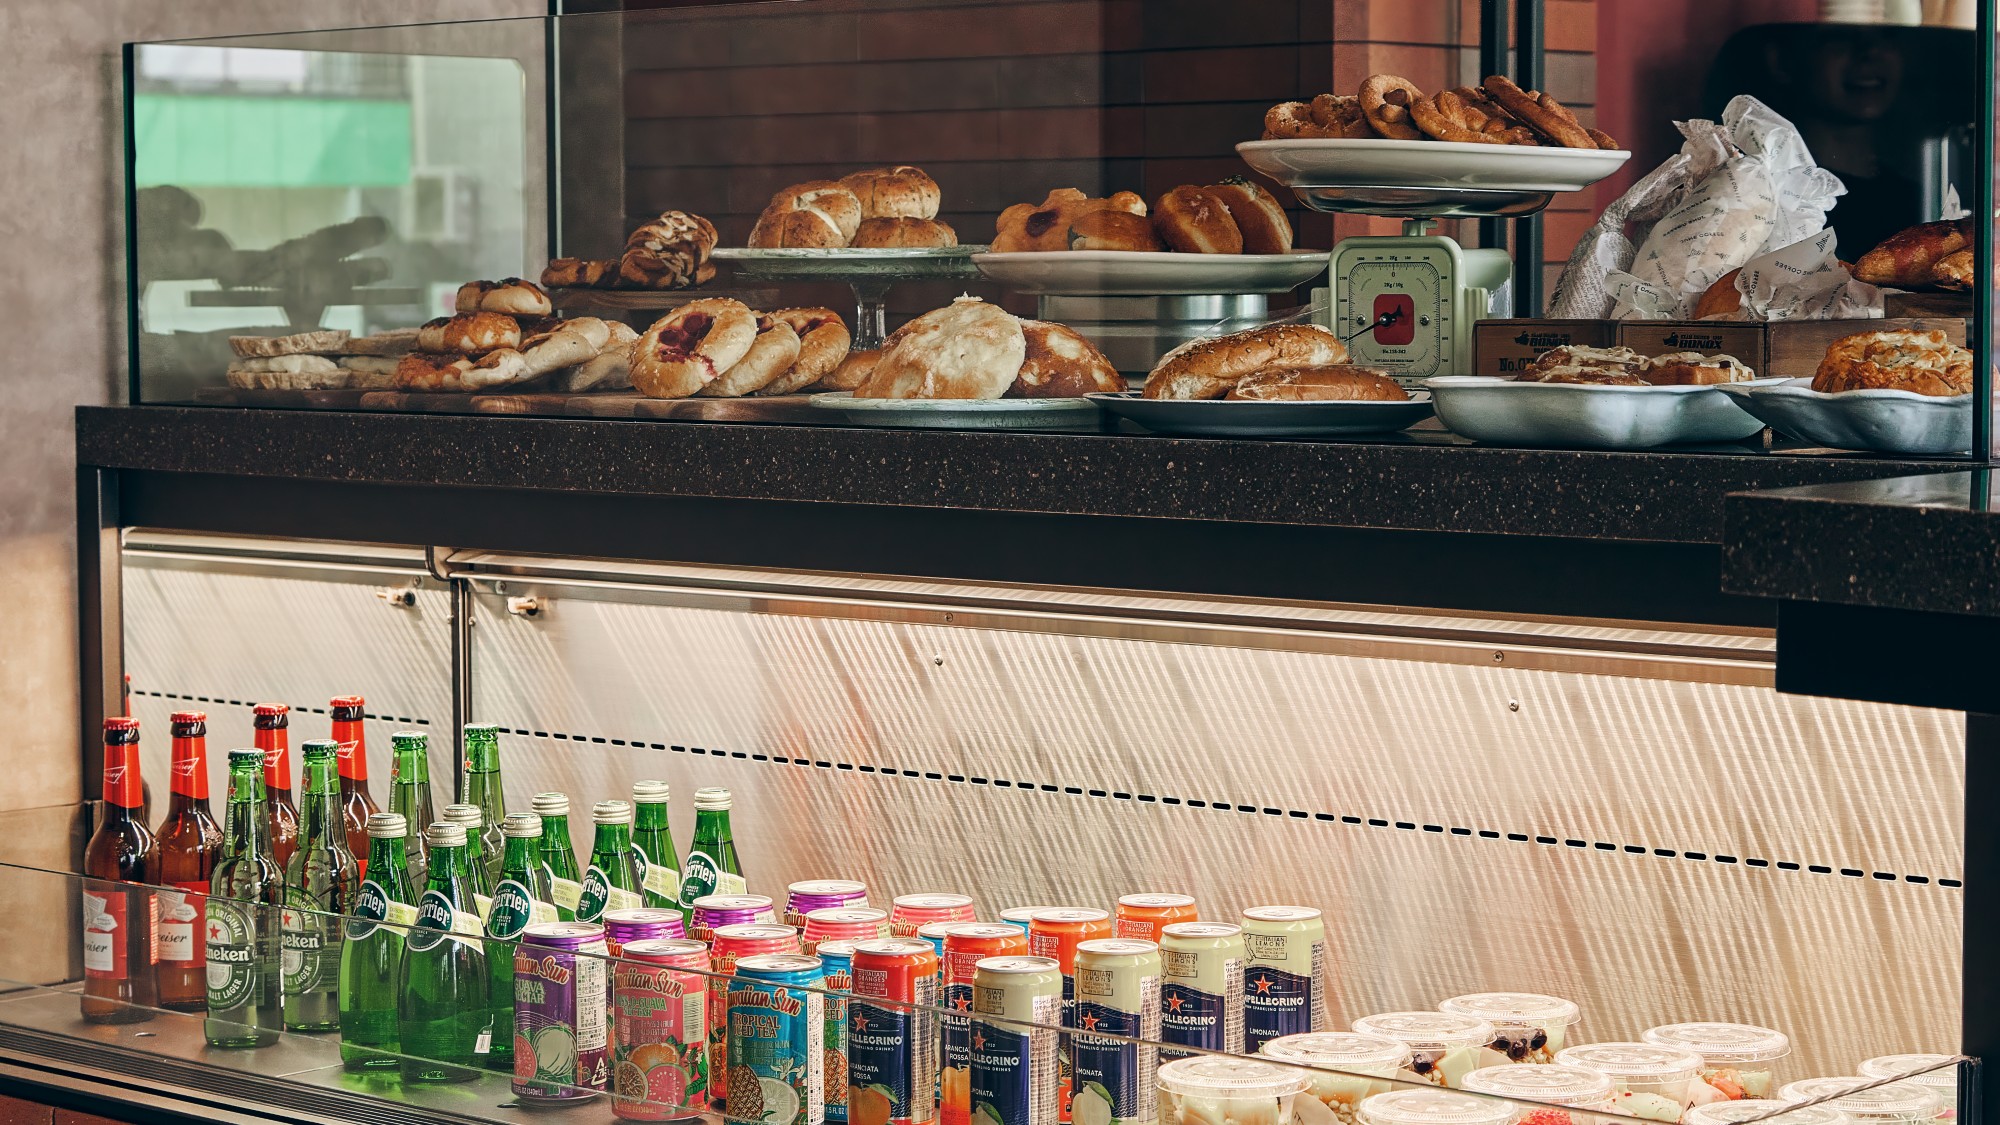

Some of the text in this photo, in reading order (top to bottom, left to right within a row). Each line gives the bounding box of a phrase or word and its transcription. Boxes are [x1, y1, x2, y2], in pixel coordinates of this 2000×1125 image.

[686, 861, 715, 887] errier
[495, 890, 529, 916] errier
[419, 900, 450, 927] errier
[282, 933, 320, 949] neken
[205, 945, 250, 962] ineken
[541, 956, 569, 985] Sun
[222, 979, 243, 999] LAGER
[515, 977, 545, 993] GUAVA
[653, 969, 683, 999] Sun
[770, 986, 802, 1016] Sun
[1245, 994, 1305, 1007] PELLEGRINO
[756, 1026, 777, 1038] TEA
[1250, 1027, 1280, 1037] LIMONATA
[945, 1044, 969, 1053] ARANCIA
[950, 1053, 969, 1061] ROSSA
[854, 1072, 872, 1081] ROSSA
